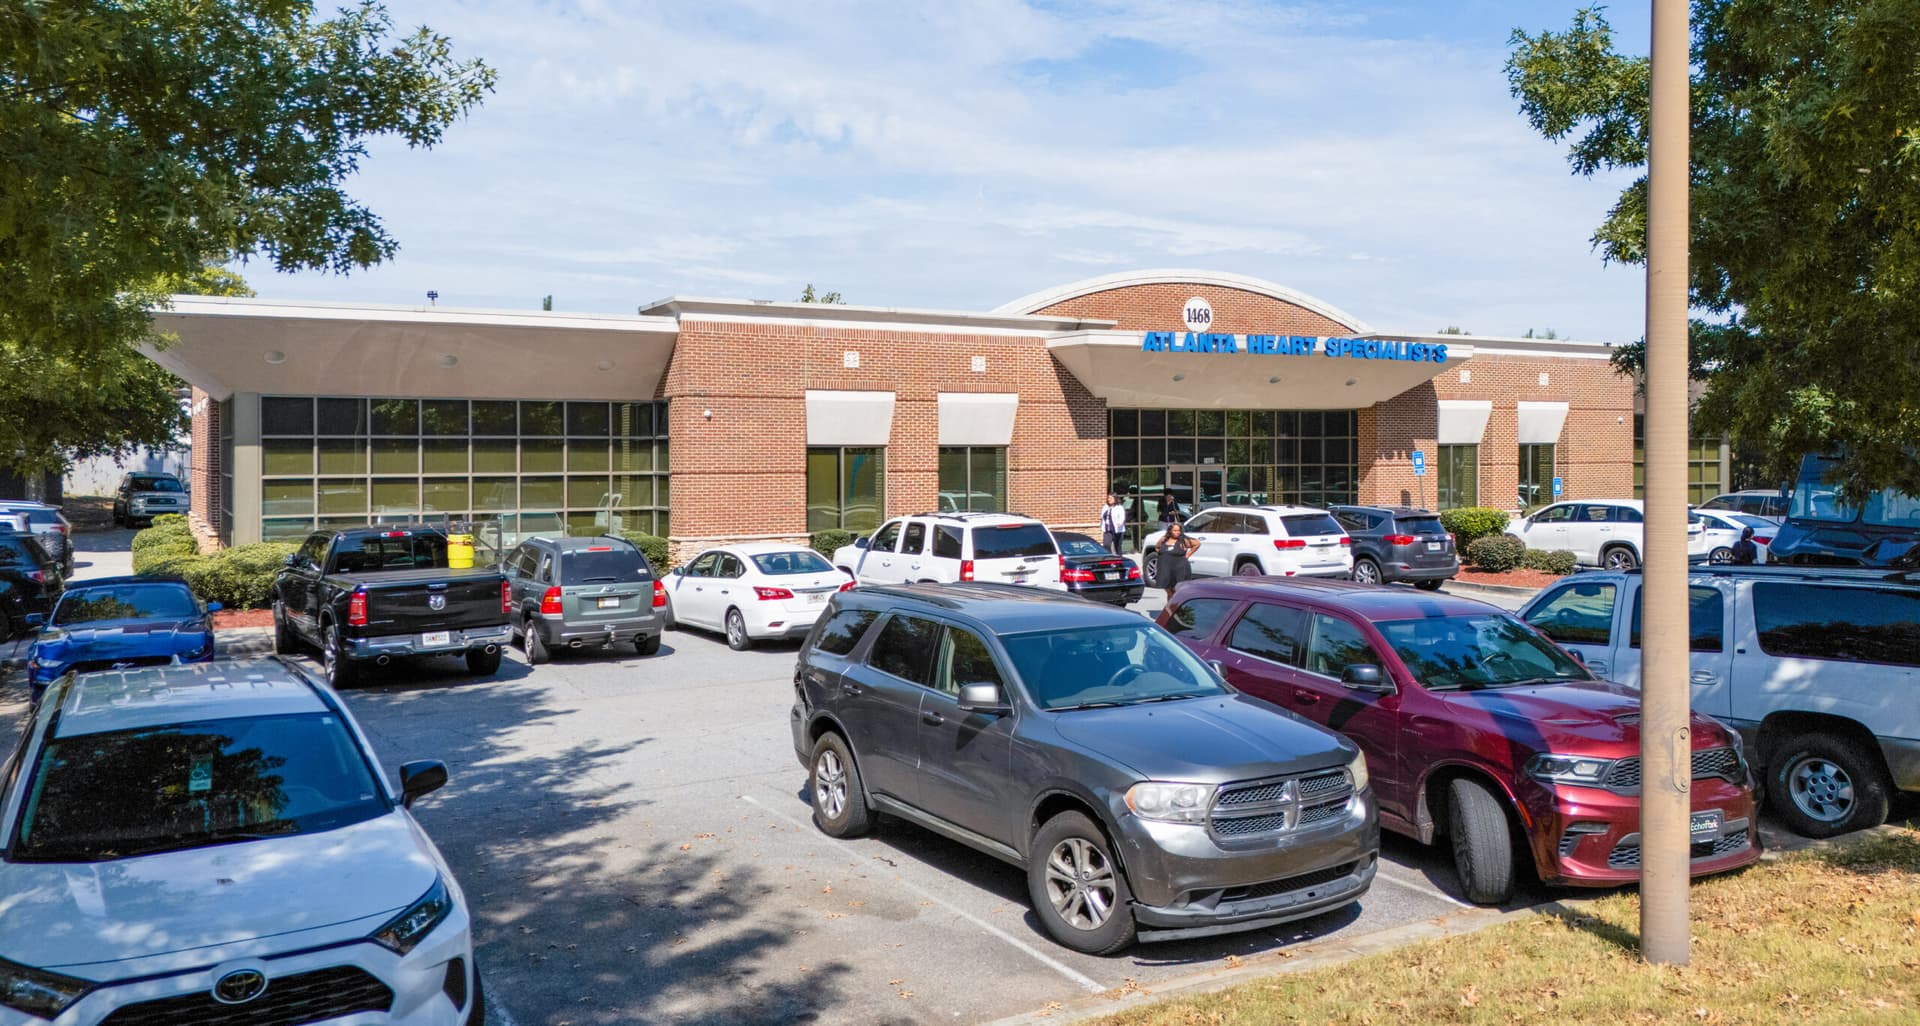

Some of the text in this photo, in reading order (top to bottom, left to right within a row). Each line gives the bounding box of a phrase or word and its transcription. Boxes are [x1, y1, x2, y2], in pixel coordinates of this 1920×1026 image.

[1186, 307, 1211, 324] 1468
[1143, 331, 1448, 363] ATLANTA HEART SPECIALISTS
